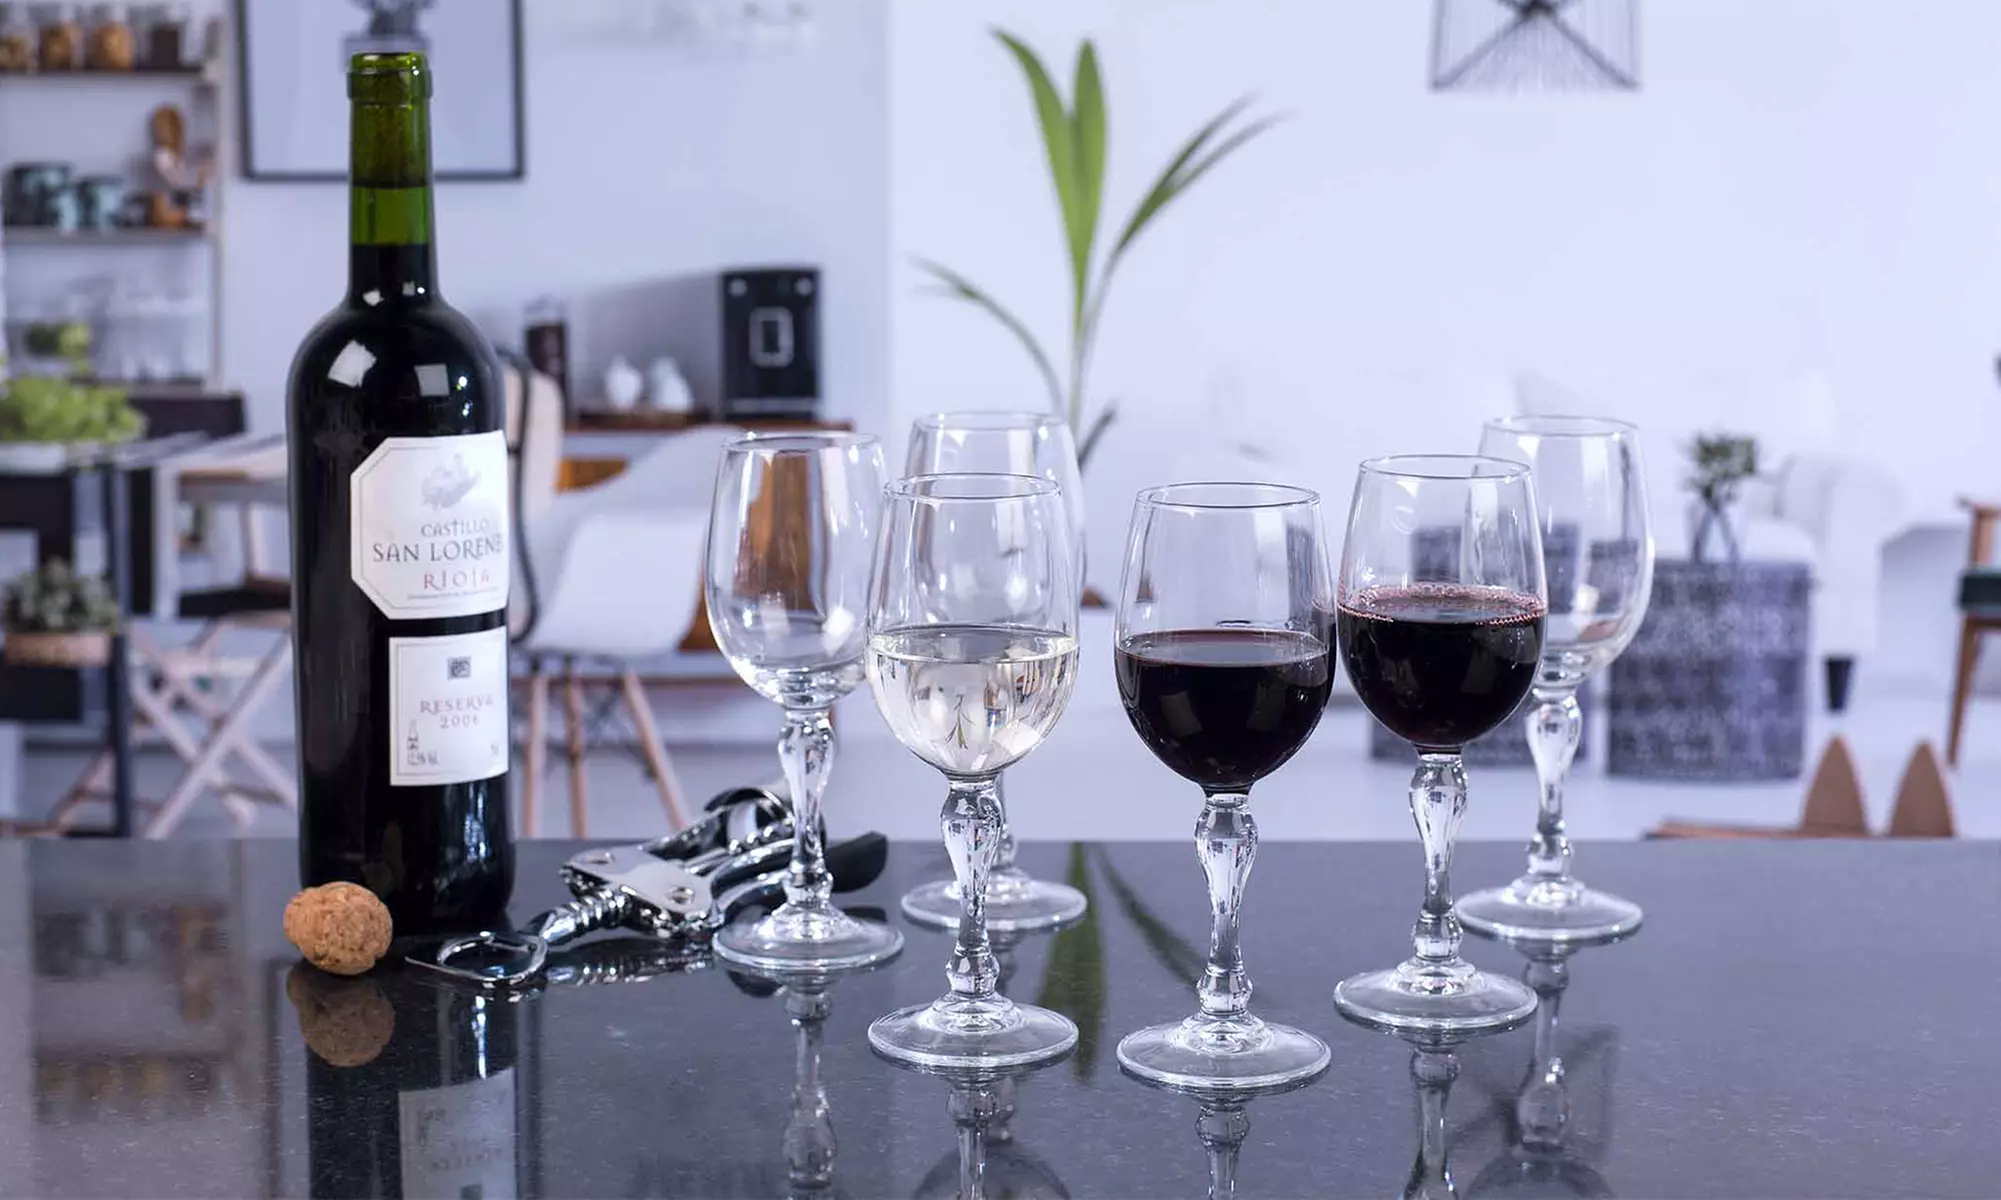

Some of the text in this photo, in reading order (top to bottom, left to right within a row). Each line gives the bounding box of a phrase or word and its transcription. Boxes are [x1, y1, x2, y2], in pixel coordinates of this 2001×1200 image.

[421, 518, 490, 538] CASTILLO
[372, 543, 420, 563] SAN
[424, 567, 490, 591] RIOJA
[420, 694, 493, 715] RESERVA
